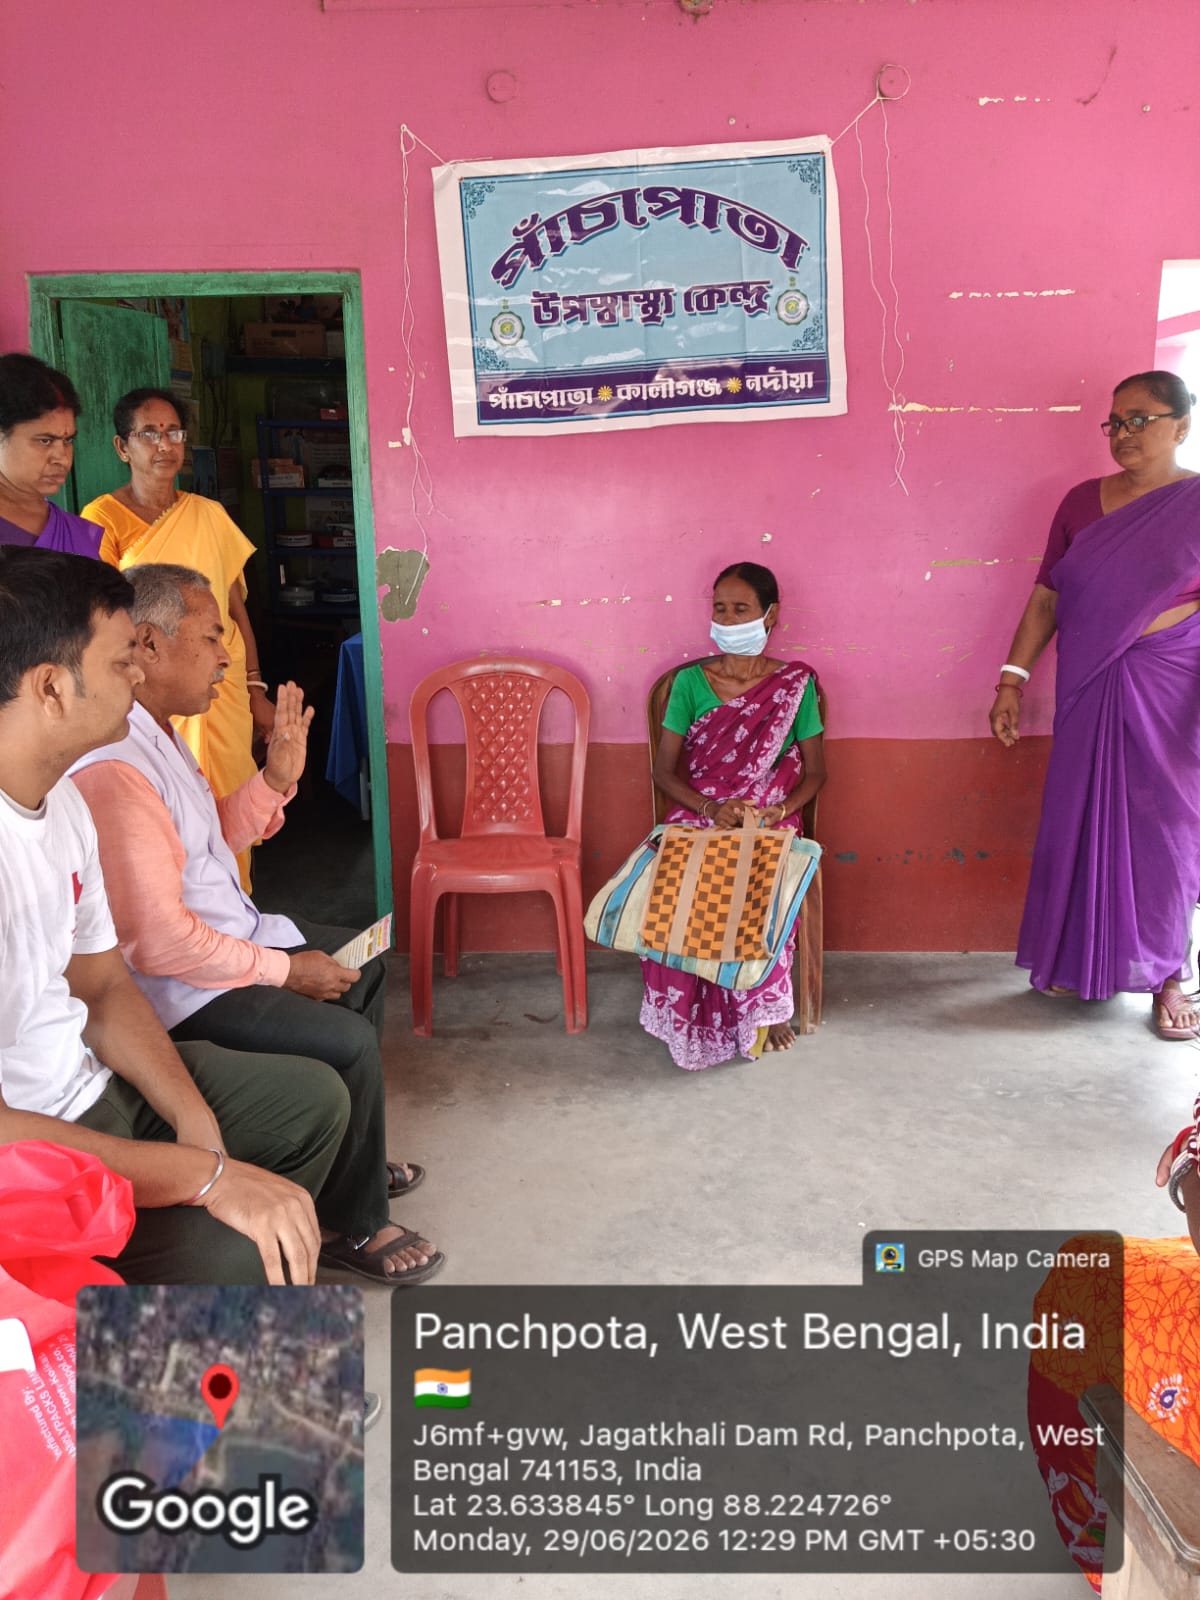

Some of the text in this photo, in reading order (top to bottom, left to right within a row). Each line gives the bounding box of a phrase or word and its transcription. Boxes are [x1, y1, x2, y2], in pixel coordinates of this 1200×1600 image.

[490, 186, 809, 287] পাঁচপোতা
[683, 279, 773, 317] কেন্দ্র
[487, 366, 815, 411] পাঁচপোতা কালীগঞ্জ নদীয়া
